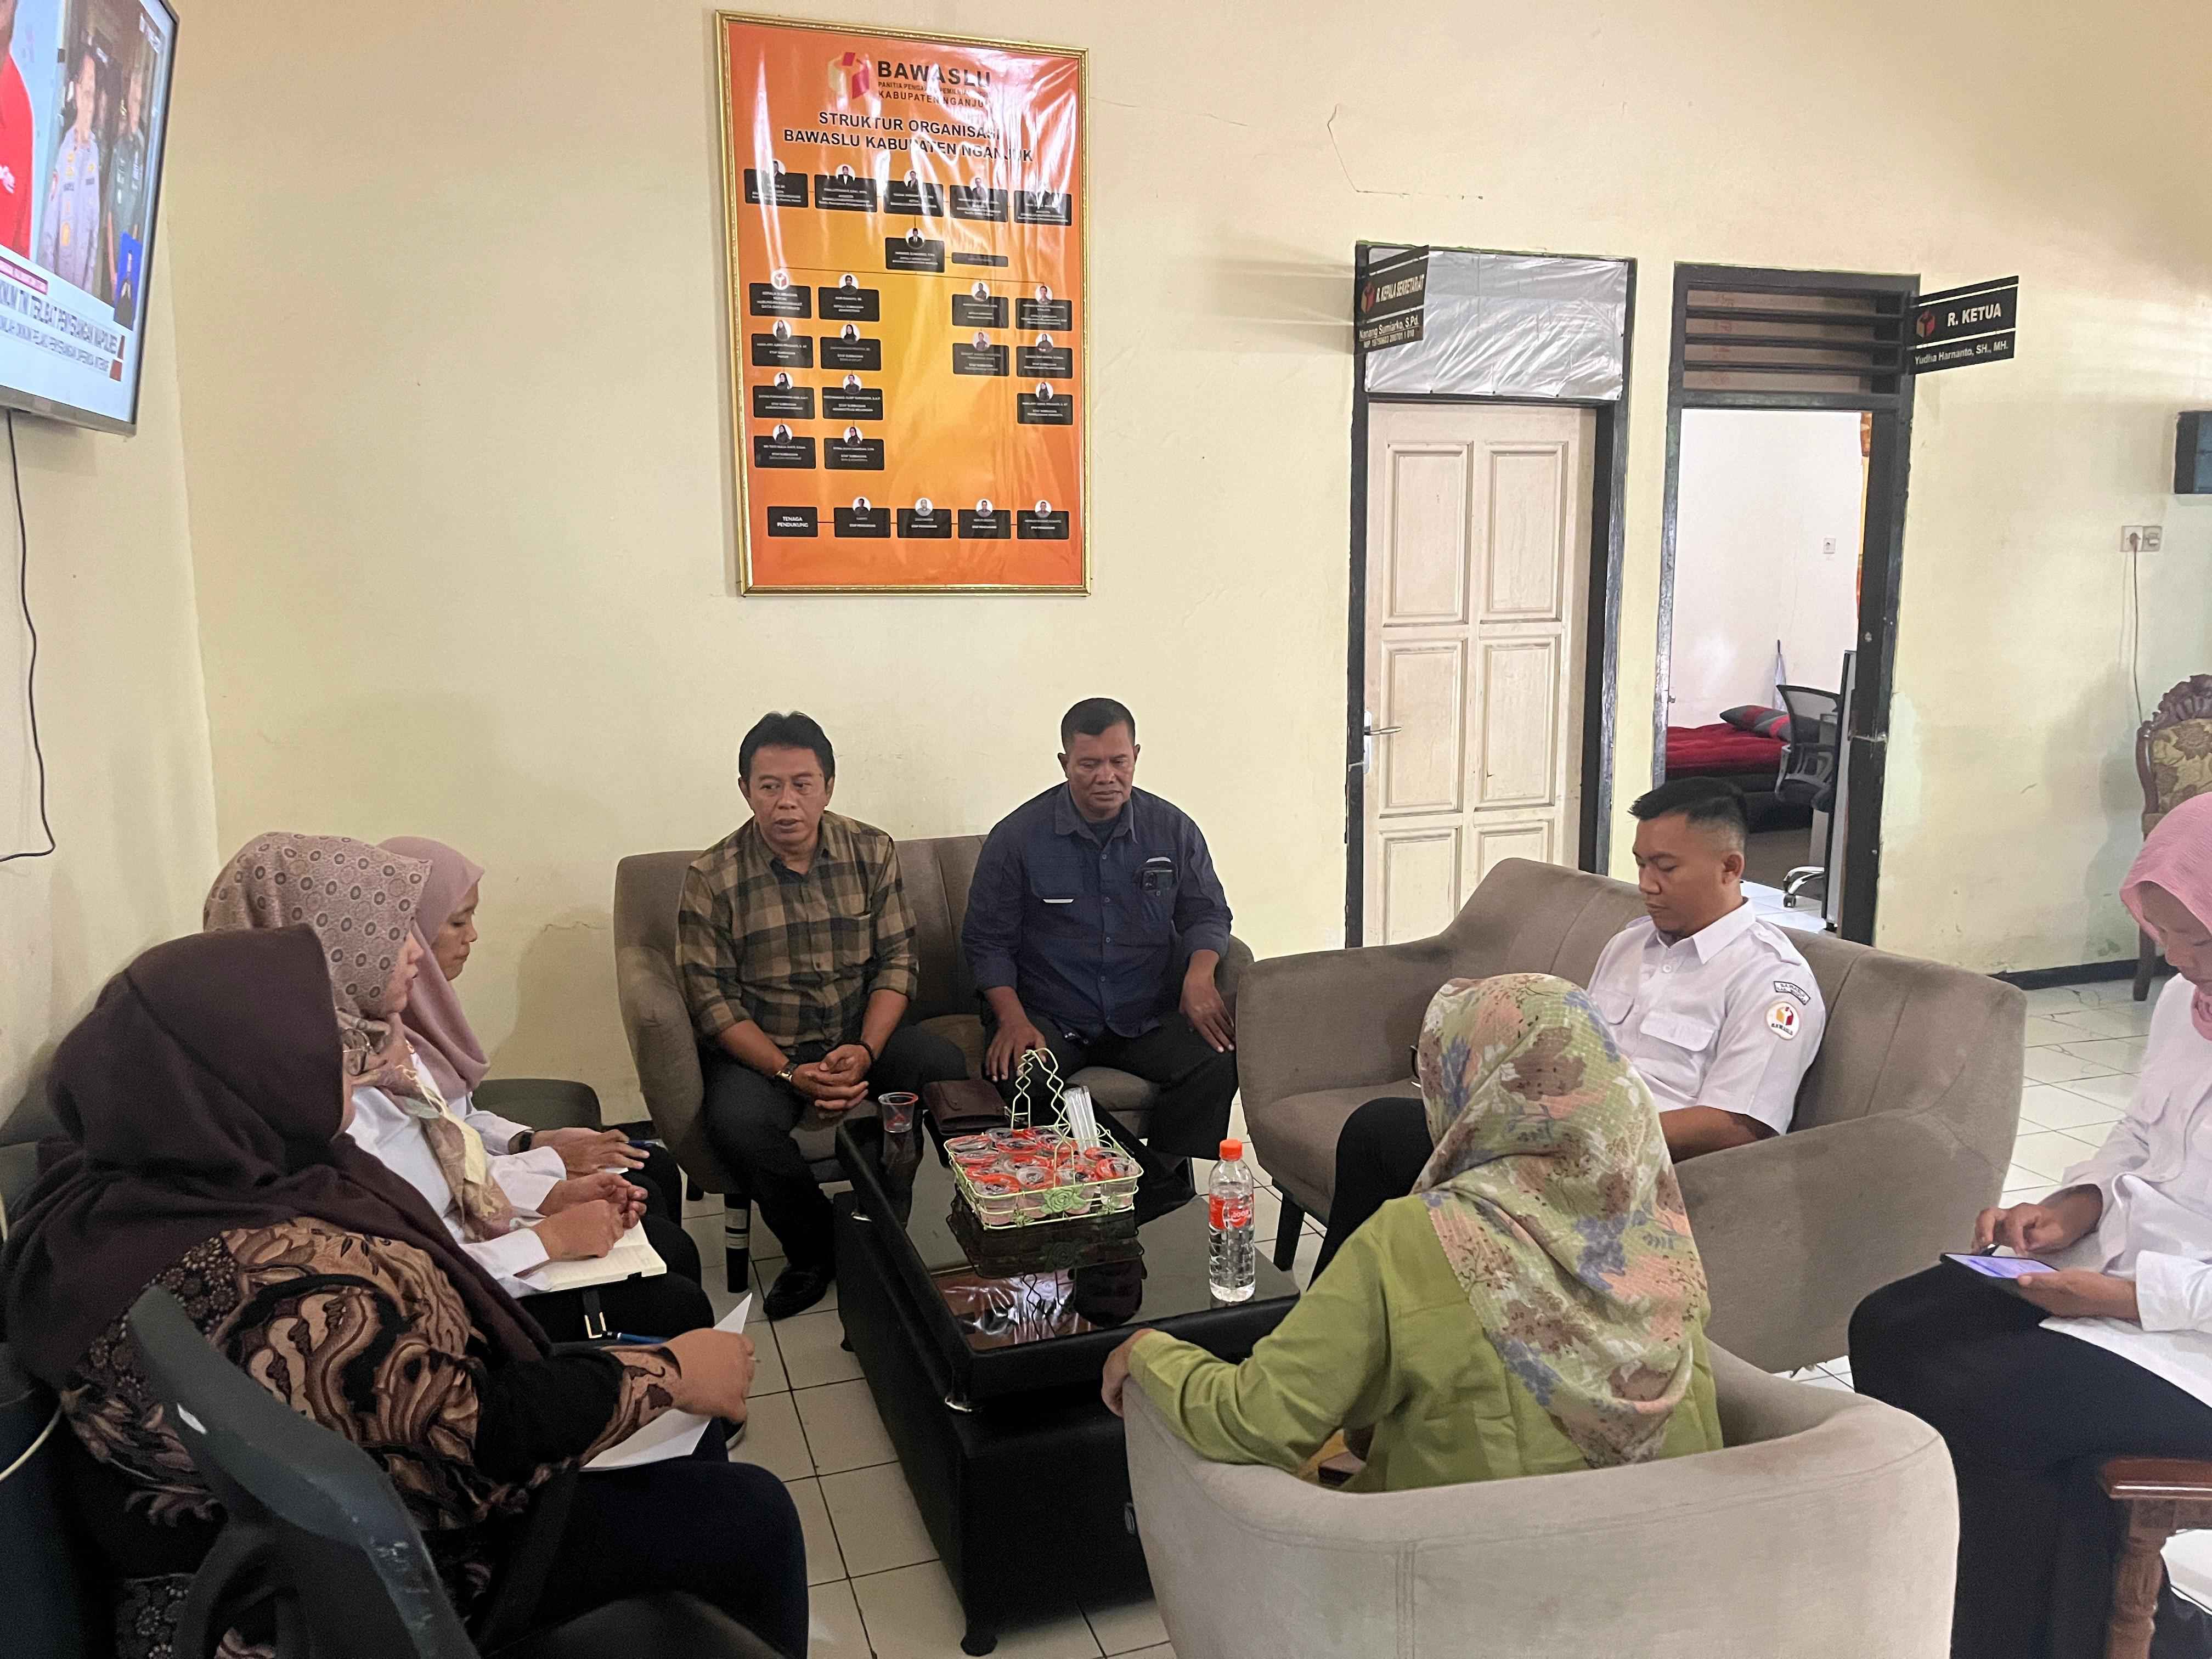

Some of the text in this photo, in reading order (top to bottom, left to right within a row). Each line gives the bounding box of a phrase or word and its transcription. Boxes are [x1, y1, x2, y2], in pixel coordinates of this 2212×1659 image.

[878, 61, 991, 87] BAWASLU
[878, 90, 939, 104] KABUPATEN
[819, 112, 904, 131] STRUKTUR
[784, 129, 860, 147] BAWASLU
[1948, 303, 2001, 326] R. KETUA
[1915, 353, 1937, 365] Yudha
